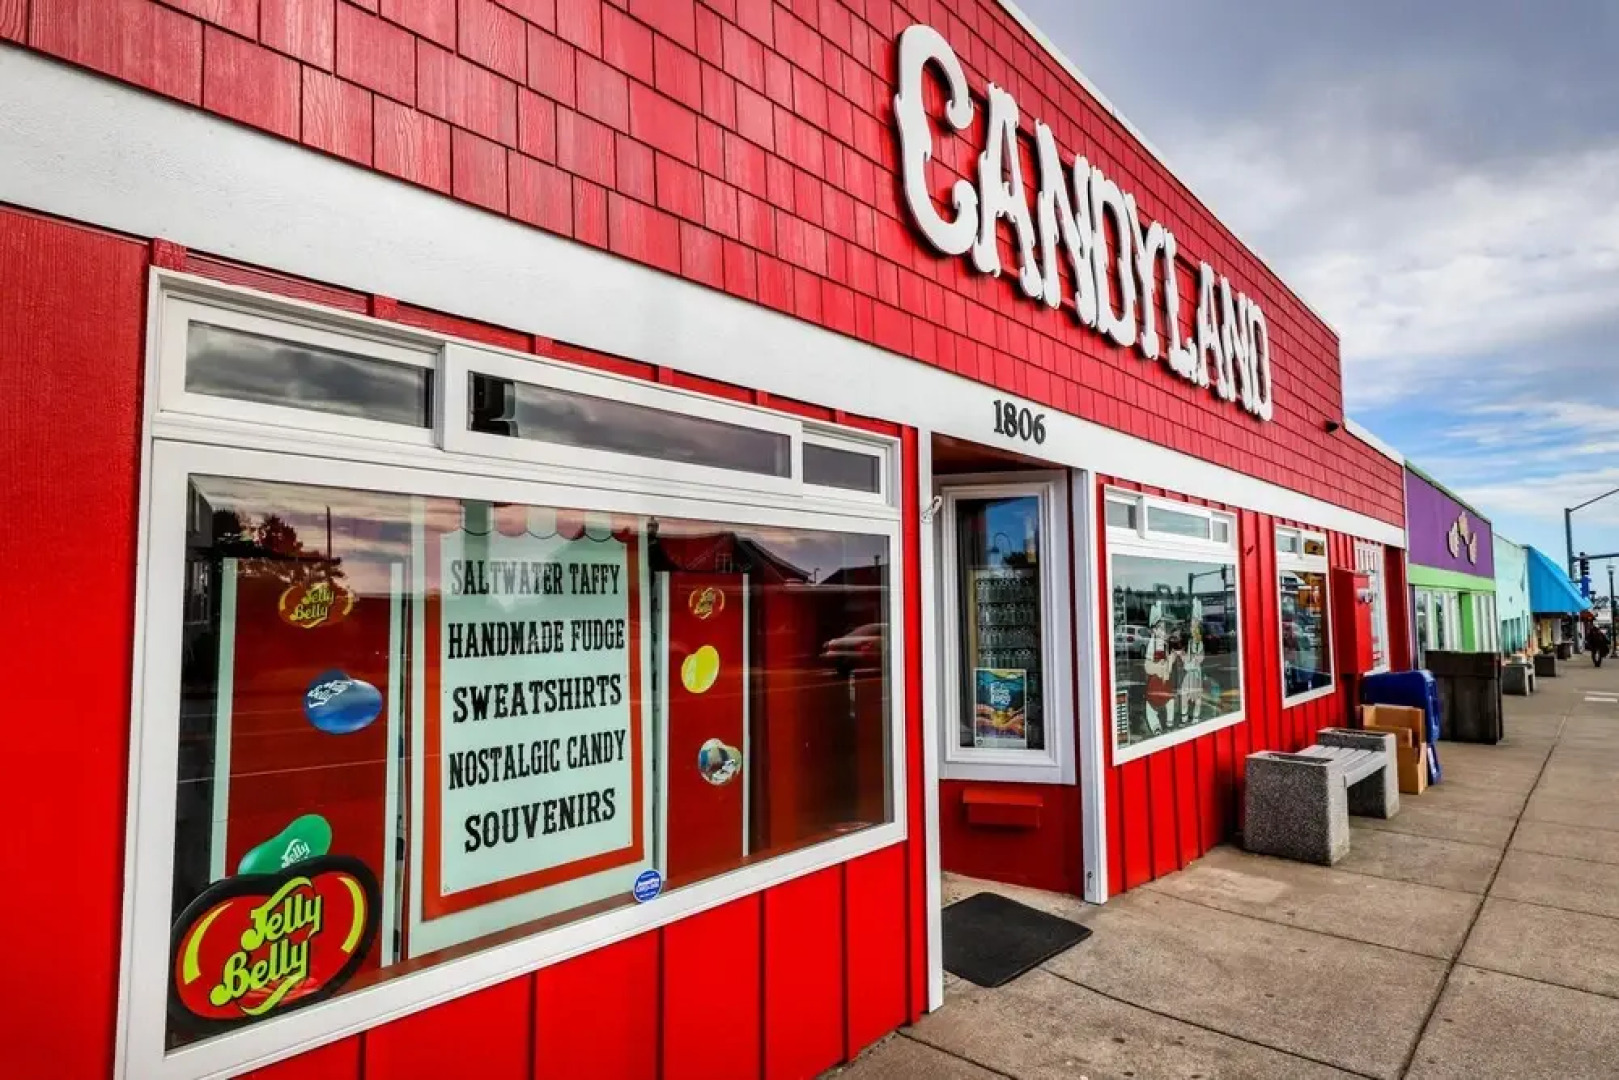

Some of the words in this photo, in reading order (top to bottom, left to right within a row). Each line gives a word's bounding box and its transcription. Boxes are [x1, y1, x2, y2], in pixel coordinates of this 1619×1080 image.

[894, 24, 1272, 421] CANDYLAND
[993, 399, 1046, 444] 1806
[451, 560, 563, 595] SALTWATER
[570, 562, 620, 595] TAFFY
[290, 604, 327, 628] Belly
[448, 621, 564, 659] HANDMADE
[571, 618, 625, 653] FUDGE
[453, 674, 621, 723] SWEATSHIRTS
[449, 738, 561, 790] NOSTALGIC
[566, 729, 626, 769] CANDY
[464, 788, 616, 854] SOUVENIRS
[241, 877, 321, 951] Jelly
[210, 939, 308, 1015] Belly
